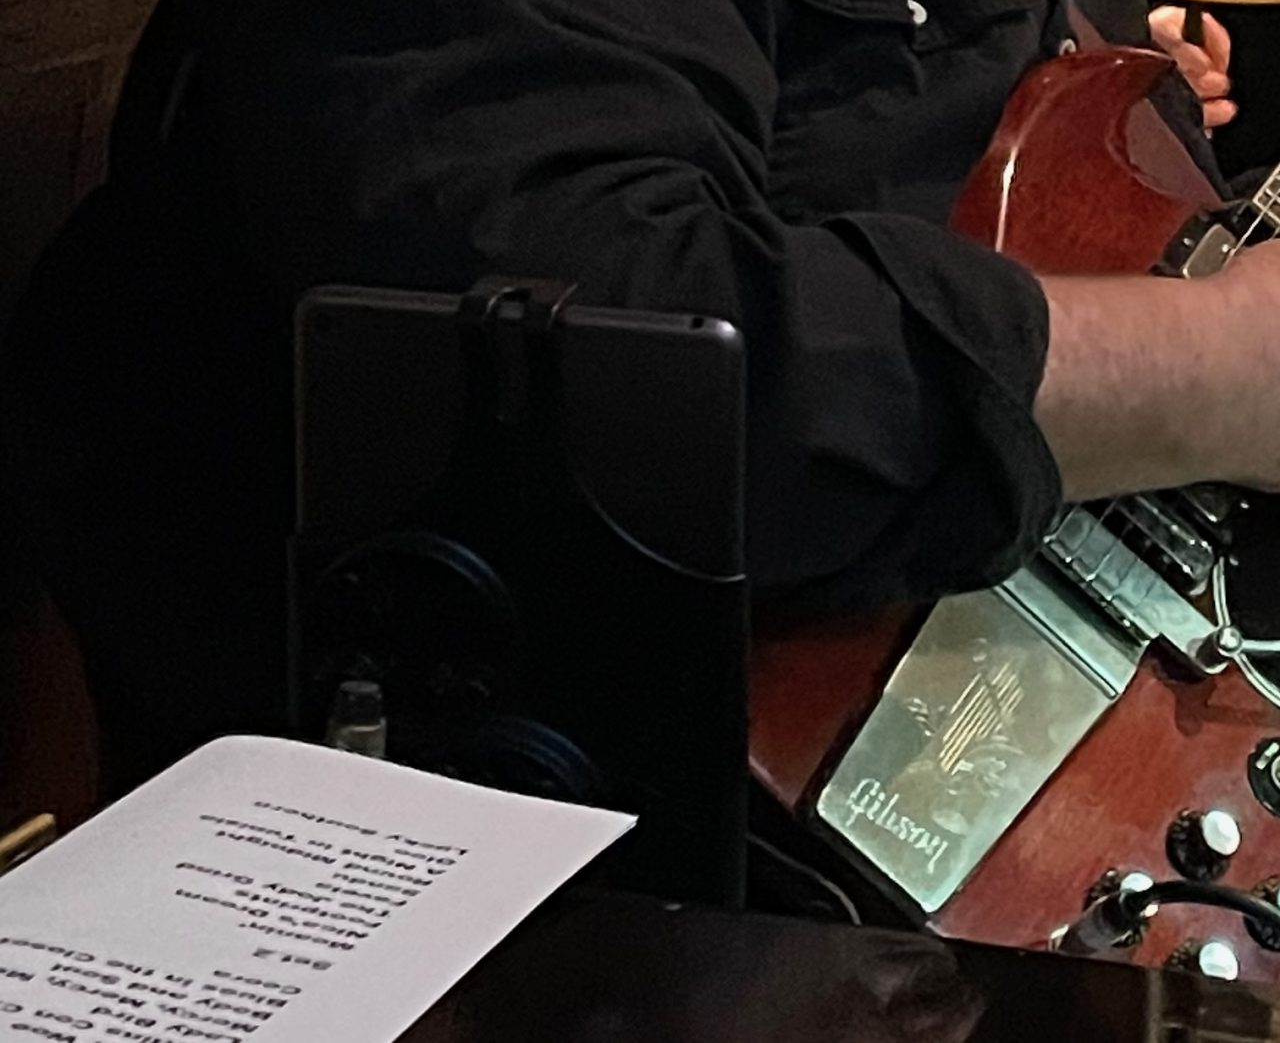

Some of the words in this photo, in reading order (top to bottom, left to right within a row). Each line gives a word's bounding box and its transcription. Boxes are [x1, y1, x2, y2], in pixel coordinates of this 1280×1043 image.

[199, 814, 296, 843] Tunisia
[253, 800, 378, 836] Southern
[846, 777, 949, 875] Gibson
[215, 830, 336, 864] Midnight
[307, 839, 333, 851] in
[384, 833, 469, 857] Lucky
[341, 848, 416, 871] Night
[175, 862, 254, 885] Grind
[343, 862, 433, 886] Round
[175, 889, 269, 917] Dream
[261, 883, 332, 903] Jody
[234, 889, 382, 928] Footprints
[339, 902, 390, 919] The
[50, 963, 121, 985] Soul
[106, 959, 155, 976] the
[281, 954, 332, 971] Set
[47, 975, 147, 1008] Mercy,
[127, 981, 188, 1000] and
[165, 974, 194, 987] in
[213, 970, 302, 995] Ceora
[202, 983, 288, 1008] Blues
[34, 1009, 93, 1030] Con
[91, 1006, 157, 1028] Bird
[158, 1003, 259, 1033] Mercy,
[195, 997, 273, 1021] Body
